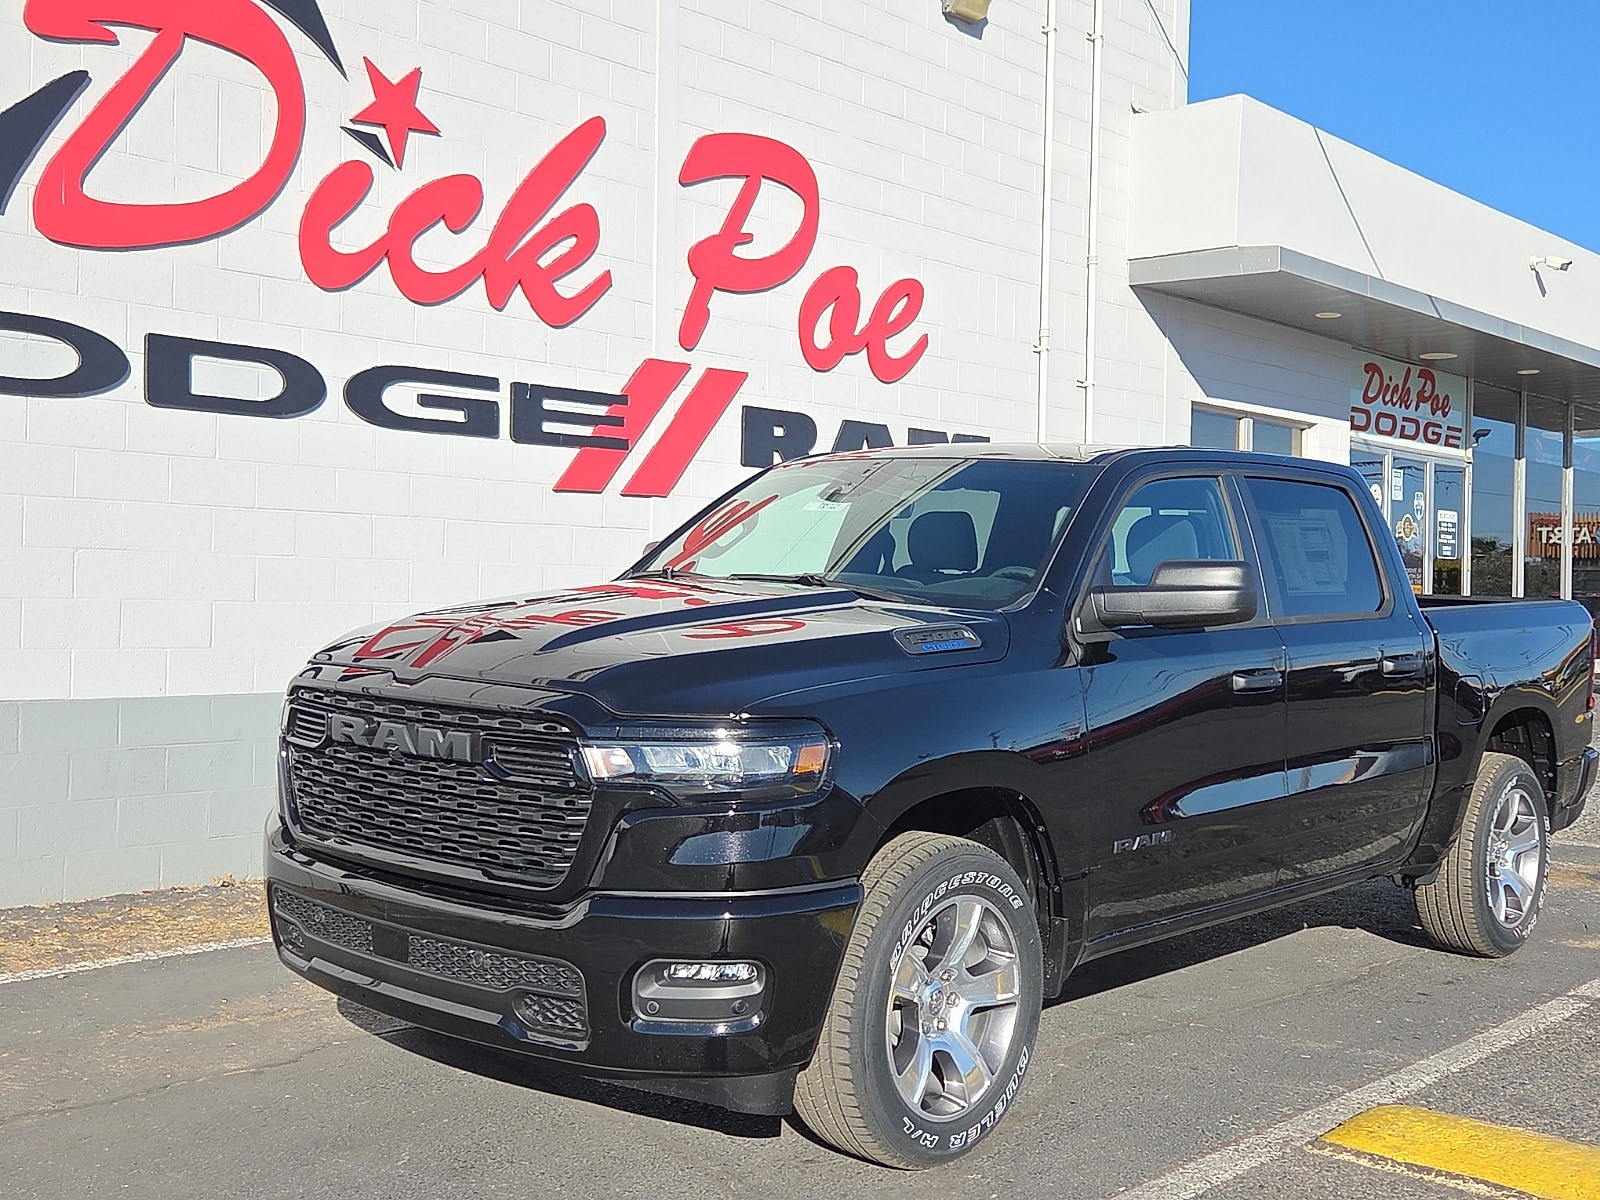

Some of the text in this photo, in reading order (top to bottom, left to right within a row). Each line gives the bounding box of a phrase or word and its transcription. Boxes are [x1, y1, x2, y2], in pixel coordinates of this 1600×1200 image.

[24, 0, 928, 384] Dick Poe
[1363, 362, 1451, 418] Dick Poe
[1350, 406, 1463, 449] DODGE
[332, 713, 481, 763] RAM
[1113, 830, 1174, 854] RAM
[890, 872, 1024, 974] BRIDGESTONE
[949, 1045, 1029, 1150] DUELER
